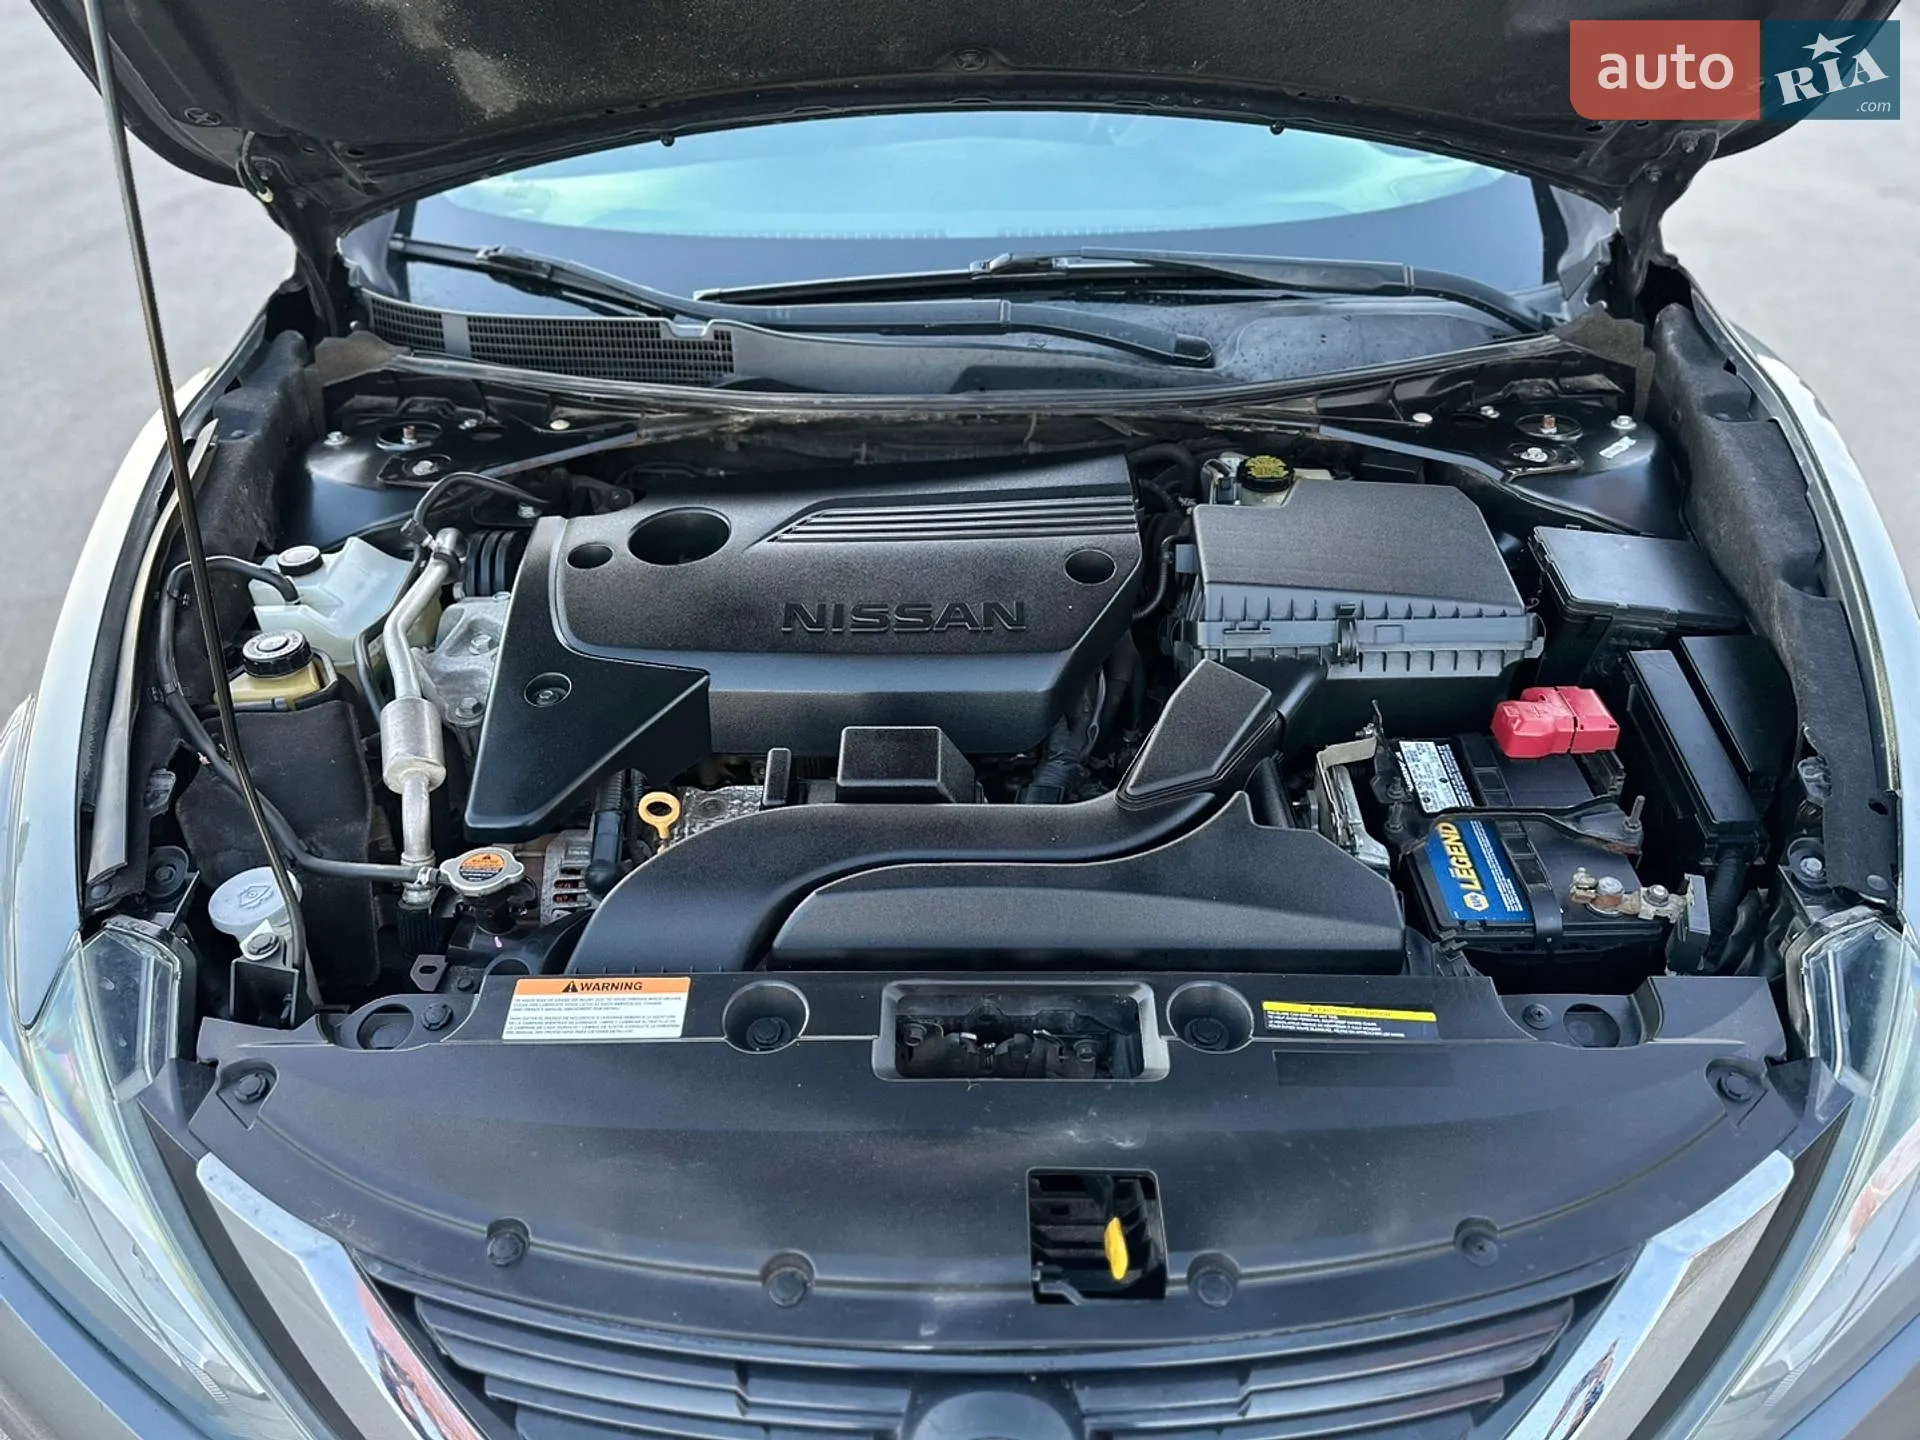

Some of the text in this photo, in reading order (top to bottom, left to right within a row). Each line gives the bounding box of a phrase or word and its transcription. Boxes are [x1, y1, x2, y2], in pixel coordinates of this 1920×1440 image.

[781, 601, 1026, 633] NISSAN
[1437, 822, 1482, 891] LEGEND
[580, 981, 643, 992] WARNING
